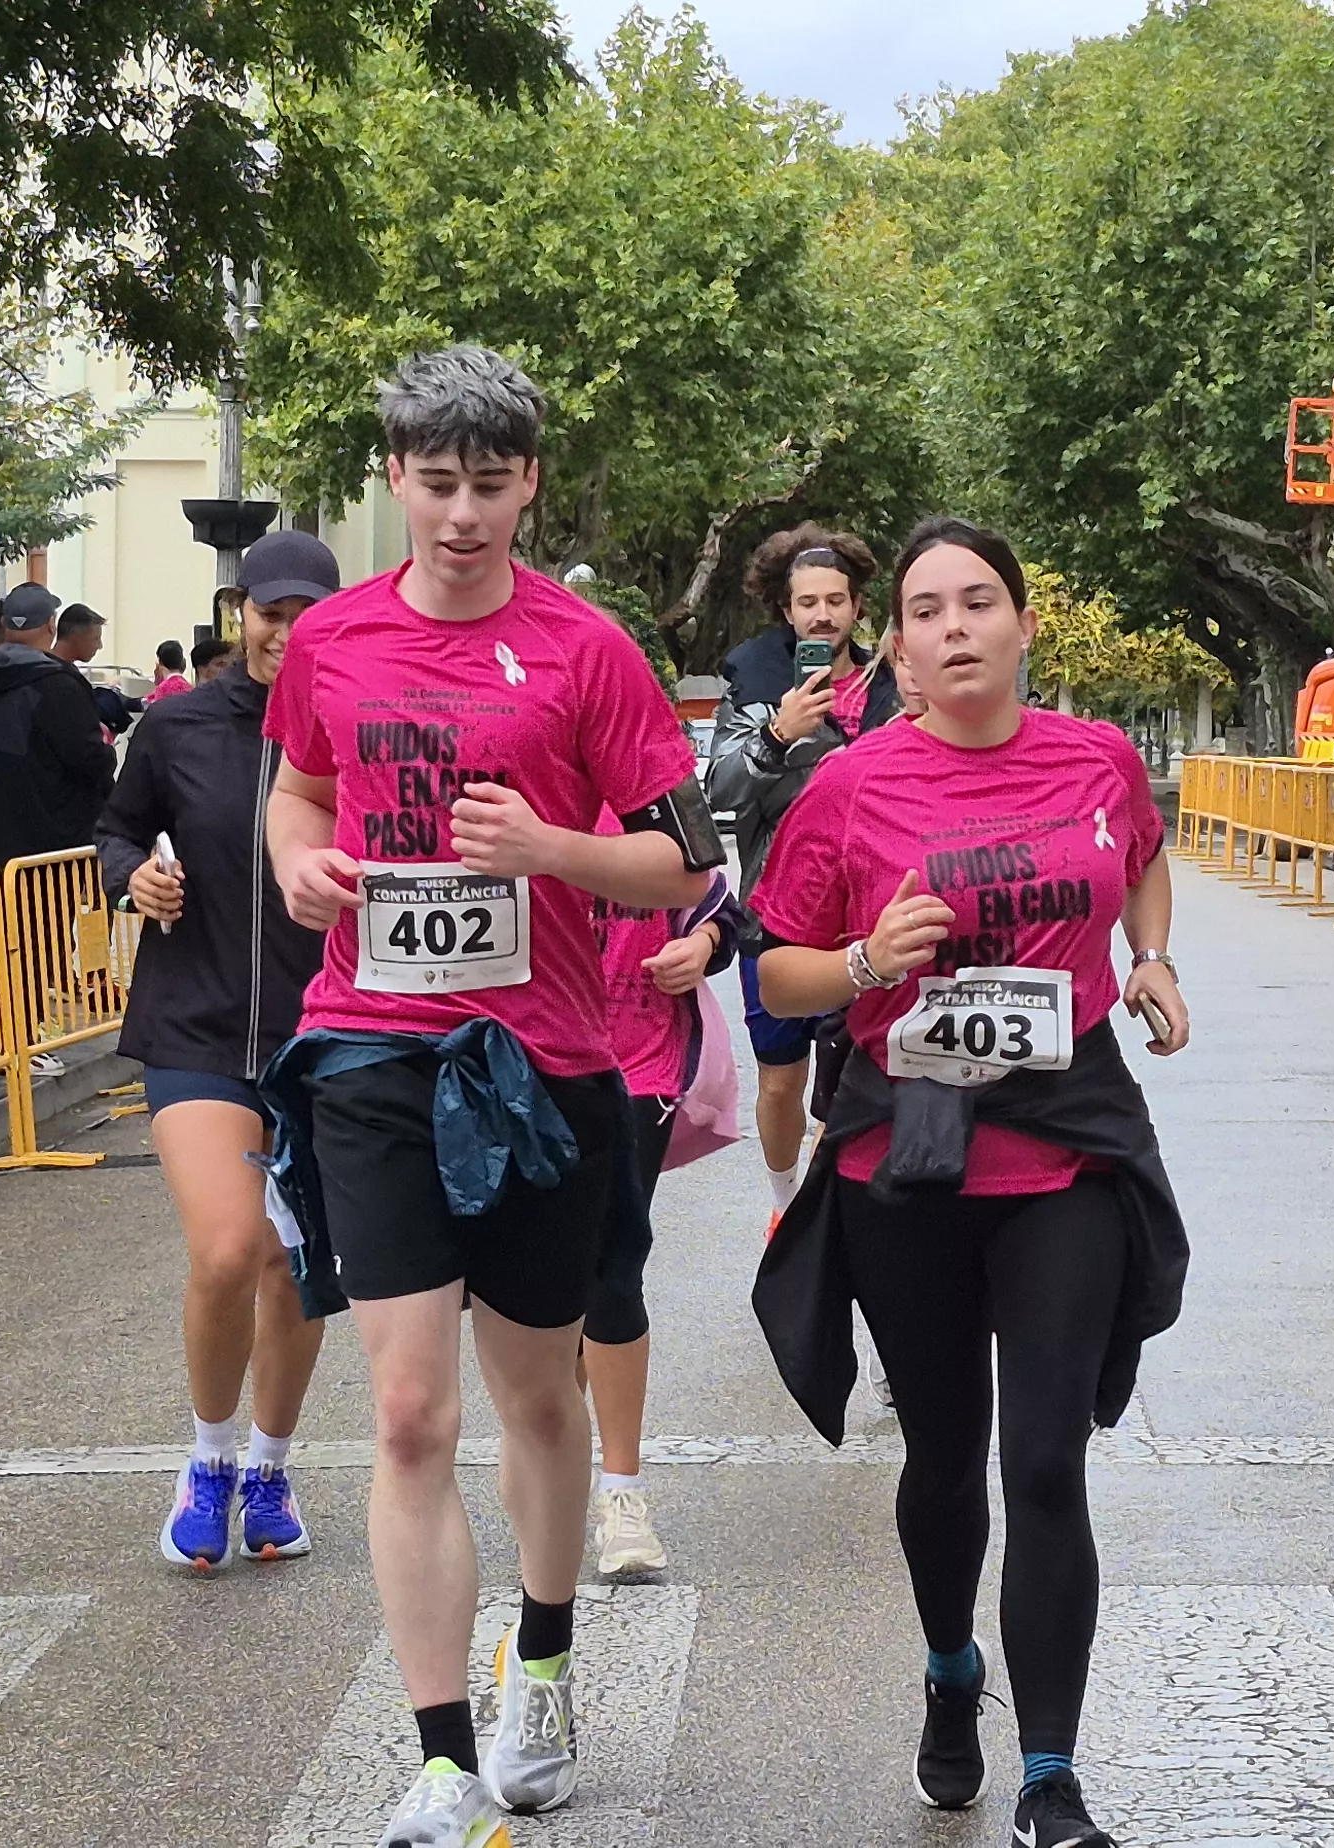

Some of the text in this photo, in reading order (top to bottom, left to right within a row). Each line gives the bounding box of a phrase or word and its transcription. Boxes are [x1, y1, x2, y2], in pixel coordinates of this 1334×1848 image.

[397, 765, 433, 808] EN
[372, 883, 509, 902] CONTRA EL CÁNCER
[416, 878, 460, 889] HUESCA
[977, 878, 1092, 929] EN CADA
[388, 907, 495, 957] 402
[973, 994, 991, 1006] EL
[993, 989, 1051, 1008] CÁNCER
[923, 1012, 1034, 1061] 403
